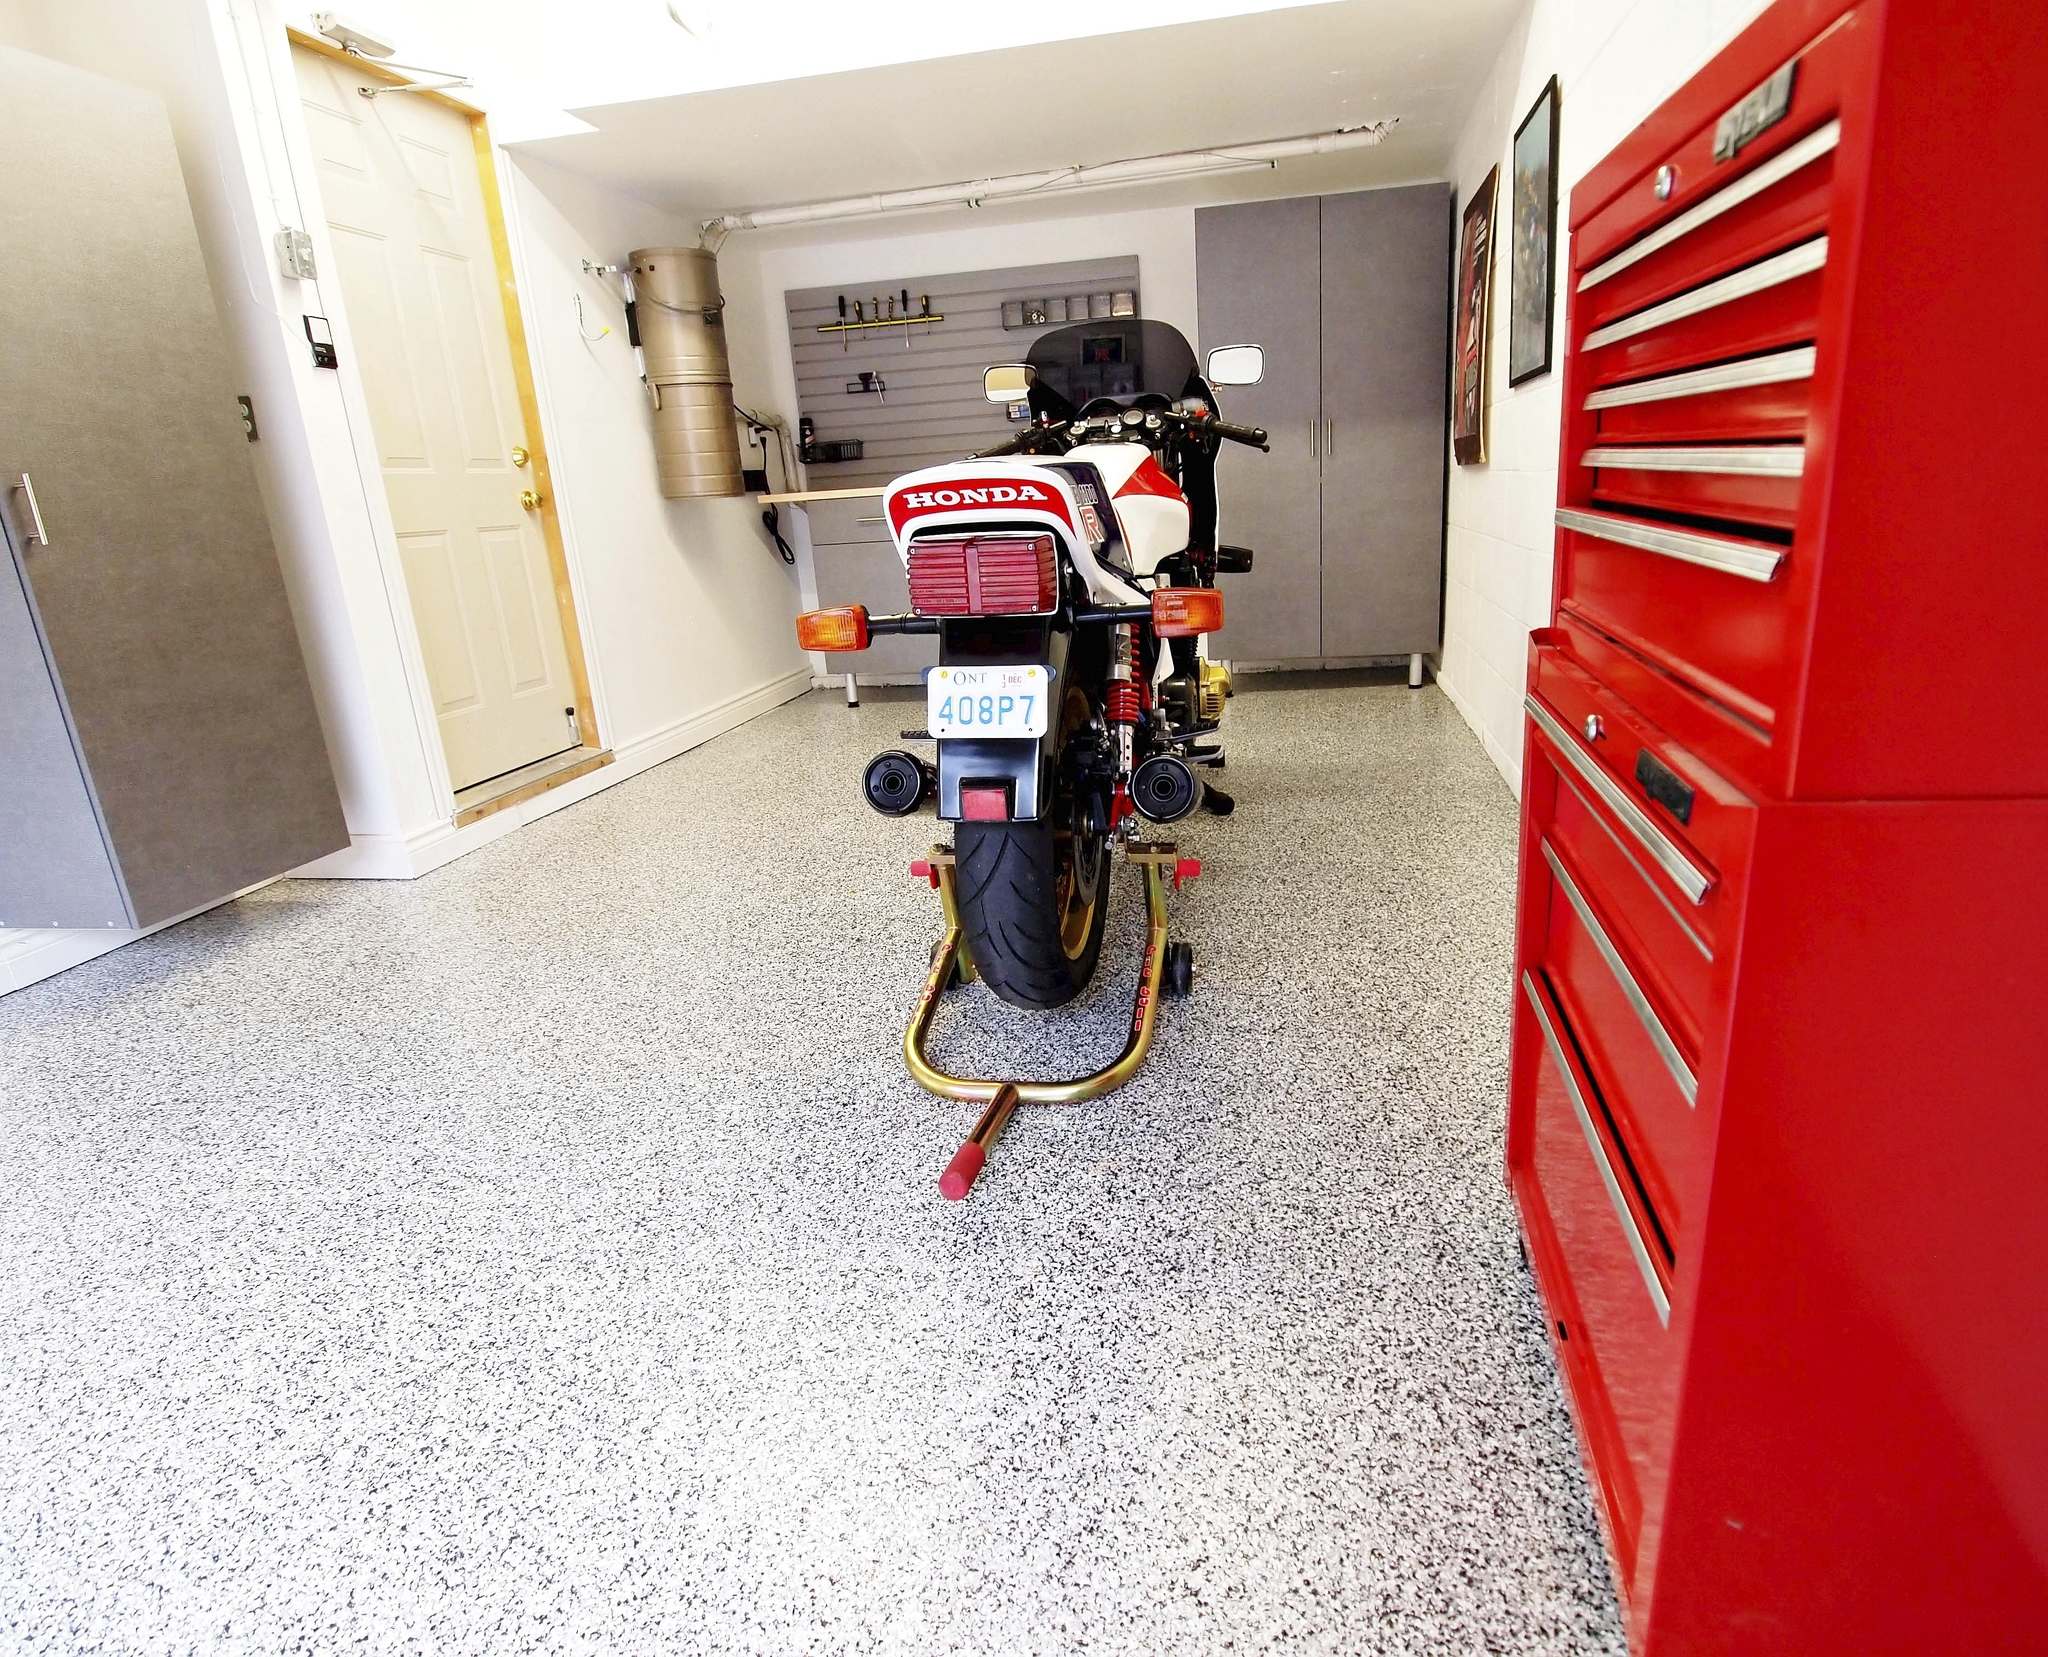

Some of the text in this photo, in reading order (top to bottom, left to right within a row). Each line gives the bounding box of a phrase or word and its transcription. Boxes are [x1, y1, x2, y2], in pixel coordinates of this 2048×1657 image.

[902, 485, 1048, 509] HONDA
[1079, 505, 1105, 544] R
[938, 695, 1037, 725] 408P7
